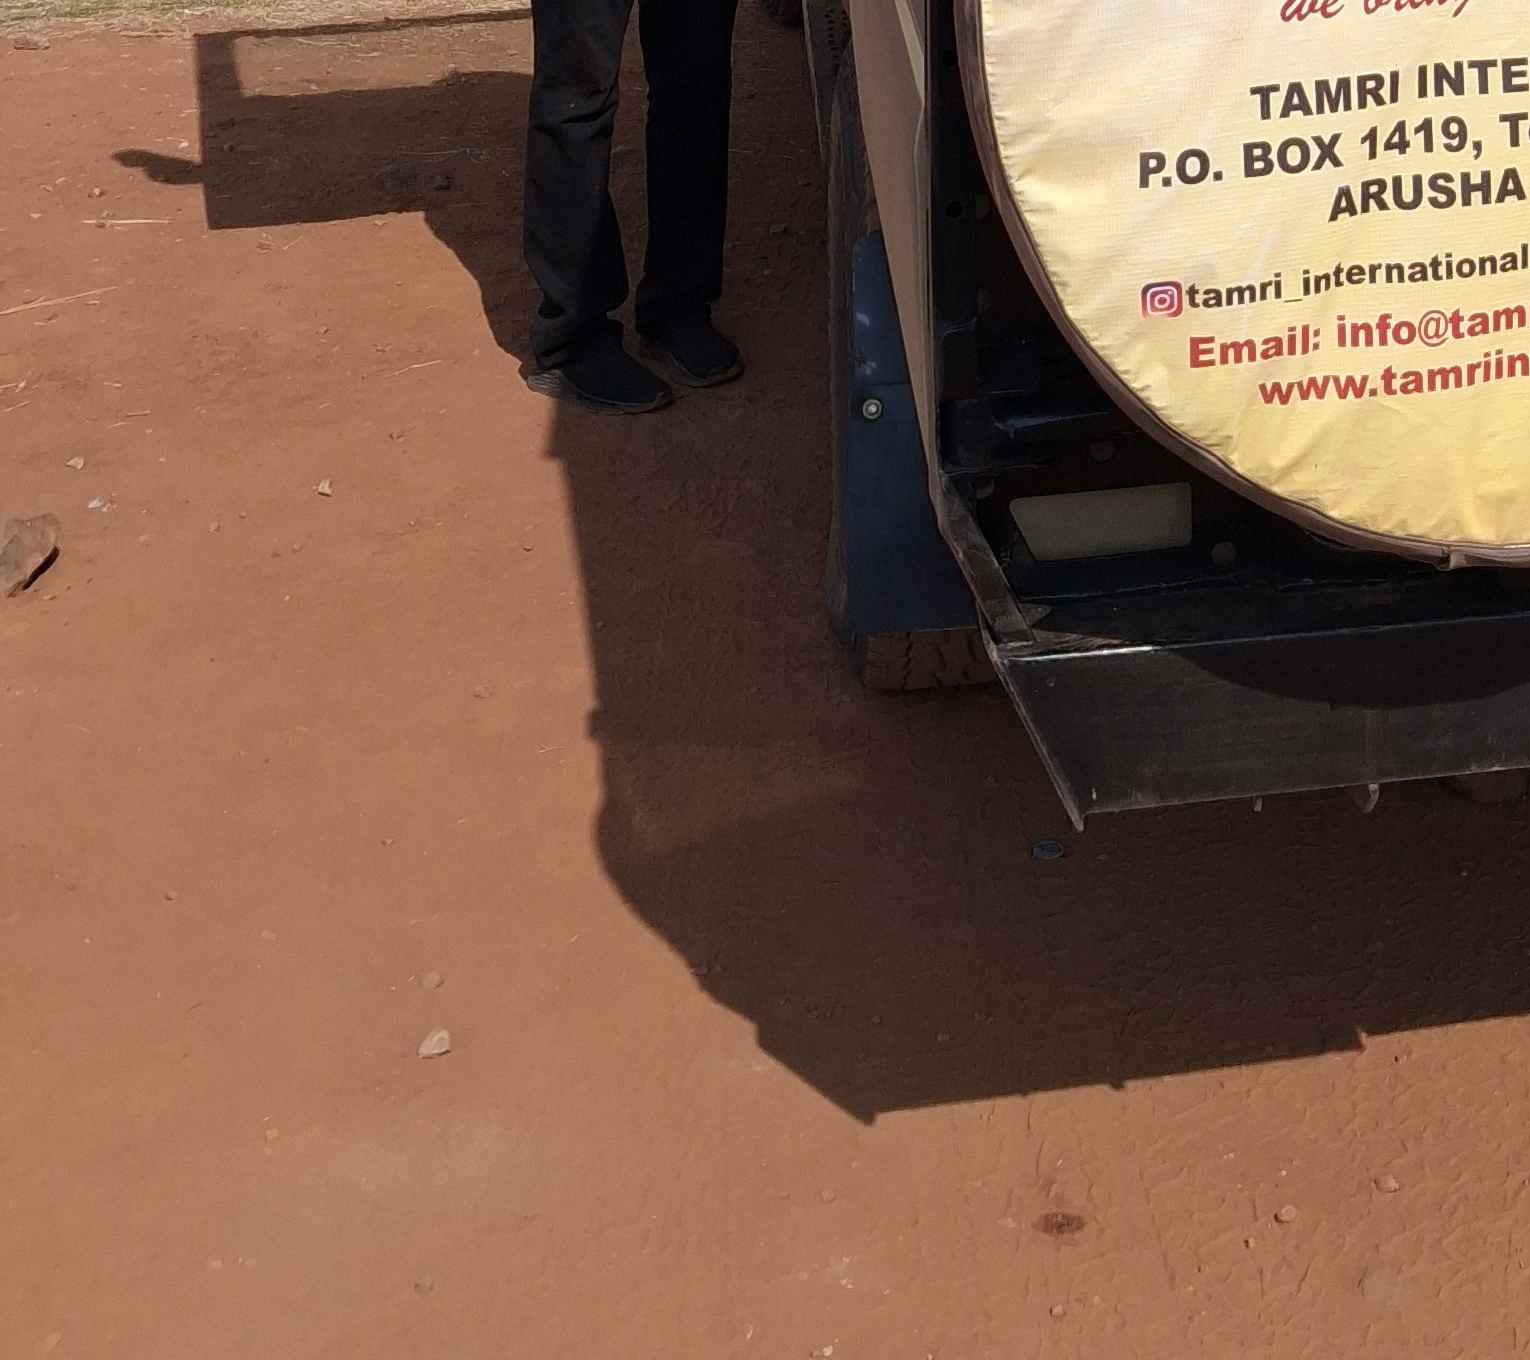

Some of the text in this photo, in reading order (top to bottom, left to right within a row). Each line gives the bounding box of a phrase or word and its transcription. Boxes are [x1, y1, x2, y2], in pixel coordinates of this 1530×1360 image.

[1249, 69, 1400, 121] TAMRI
[1138, 148, 1224, 189] P.O.
[1242, 132, 1344, 178] BOX
[1360, 115, 1483, 161] 1419,
[1328, 166, 1528, 223] ARUSHA
[1188, 323, 1321, 369] Email:
